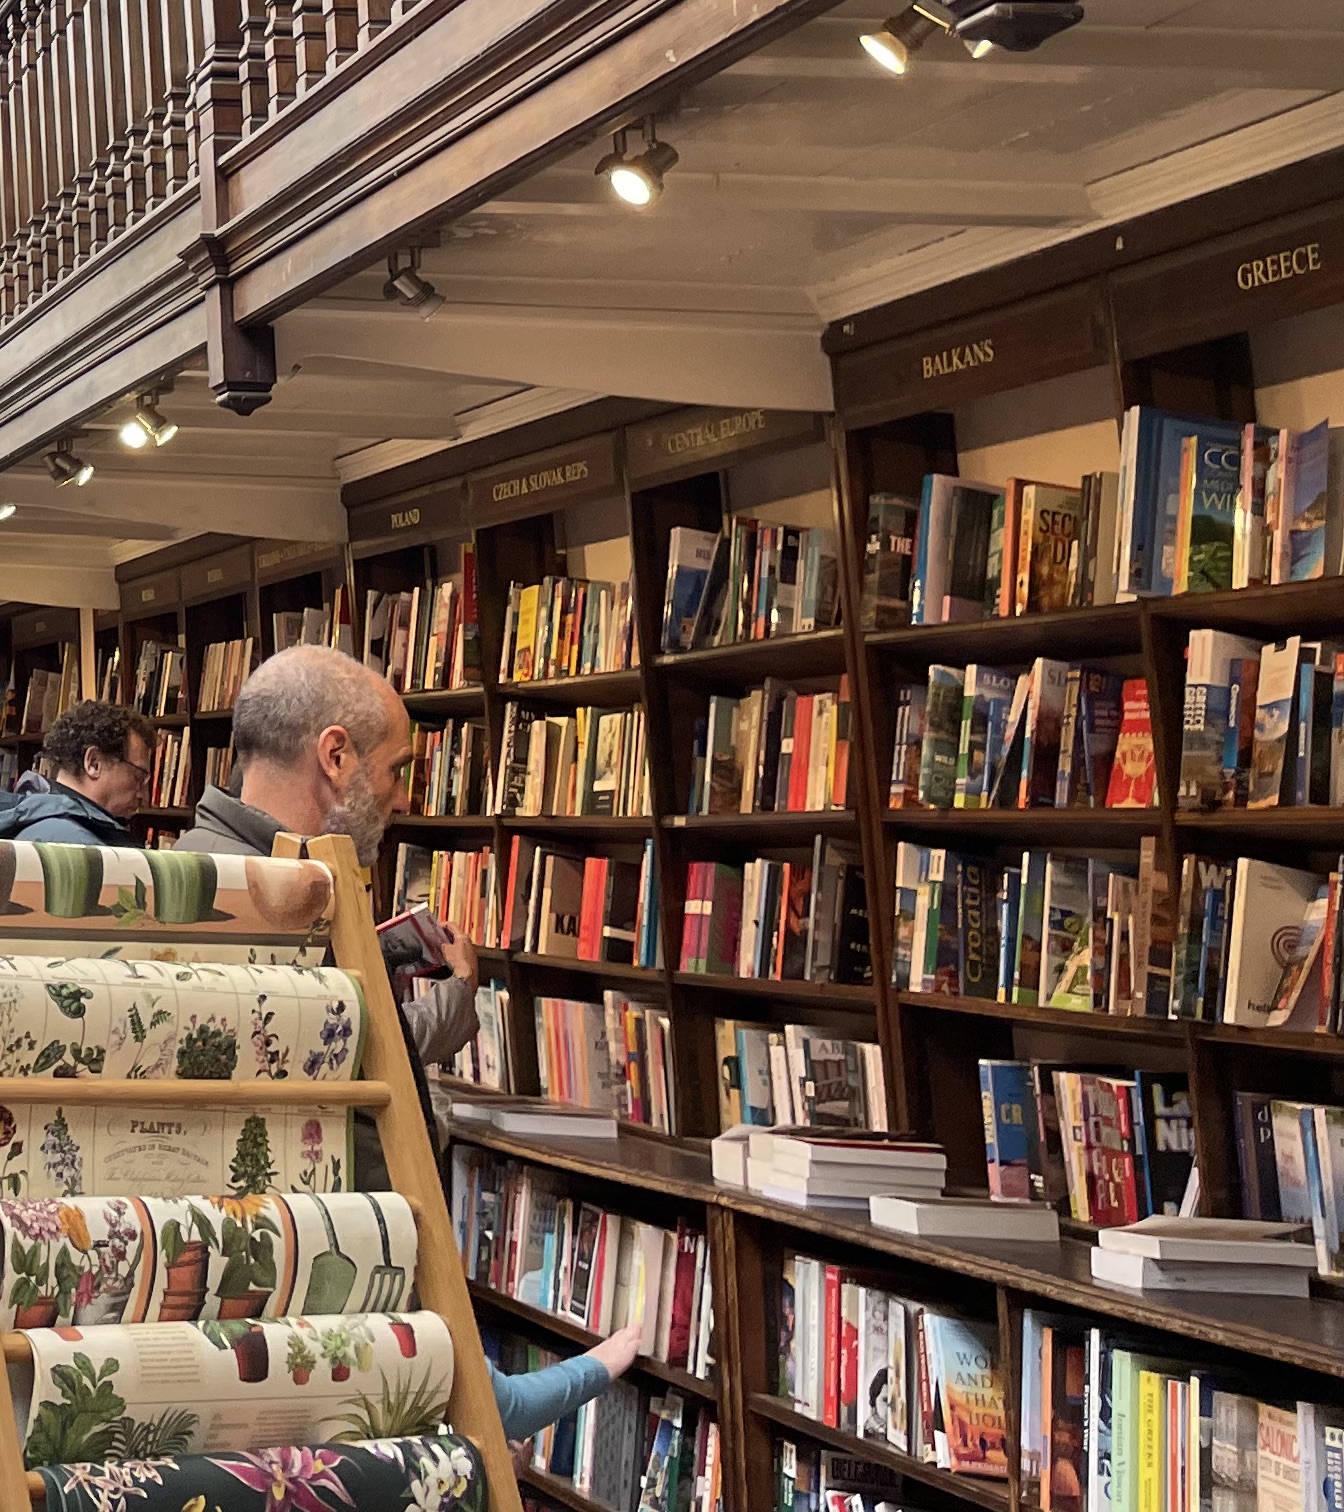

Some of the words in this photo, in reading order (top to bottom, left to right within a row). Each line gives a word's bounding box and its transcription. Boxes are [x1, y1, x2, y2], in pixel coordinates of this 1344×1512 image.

[1237, 244, 1321, 290] GREECE
[922, 339, 994, 379] BALKANS
[668, 421, 717, 454] CENTRAL
[719, 409, 765, 438] EUROPE
[391, 508, 421, 529] POLAND
[1039, 509, 1076, 537] SEC
[889, 535, 912, 555] THE
[965, 865, 984, 983] Croatia
